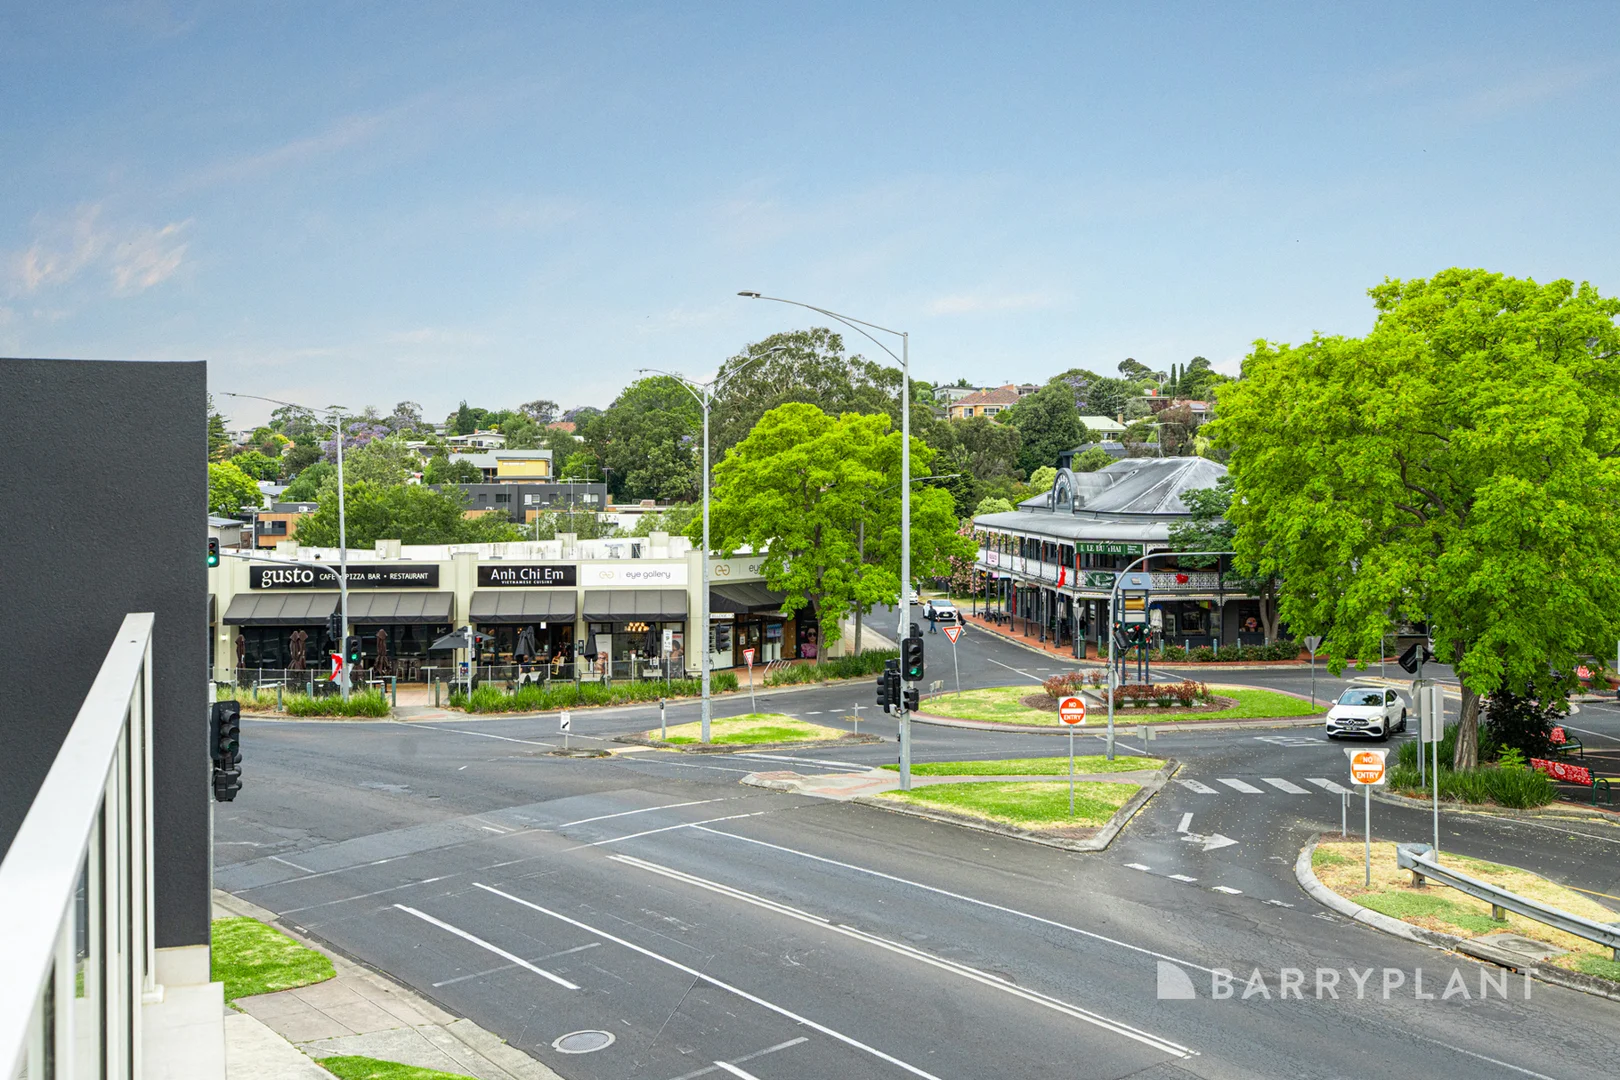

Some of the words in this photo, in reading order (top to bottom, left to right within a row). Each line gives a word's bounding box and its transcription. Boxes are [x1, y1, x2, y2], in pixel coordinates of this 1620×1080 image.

[261, 568, 314, 588] gusto
[490, 568, 516, 580] Anh
[520, 568, 540, 580] Chi
[544, 568, 564, 580] Em
[642, 570, 672, 580] gallery
